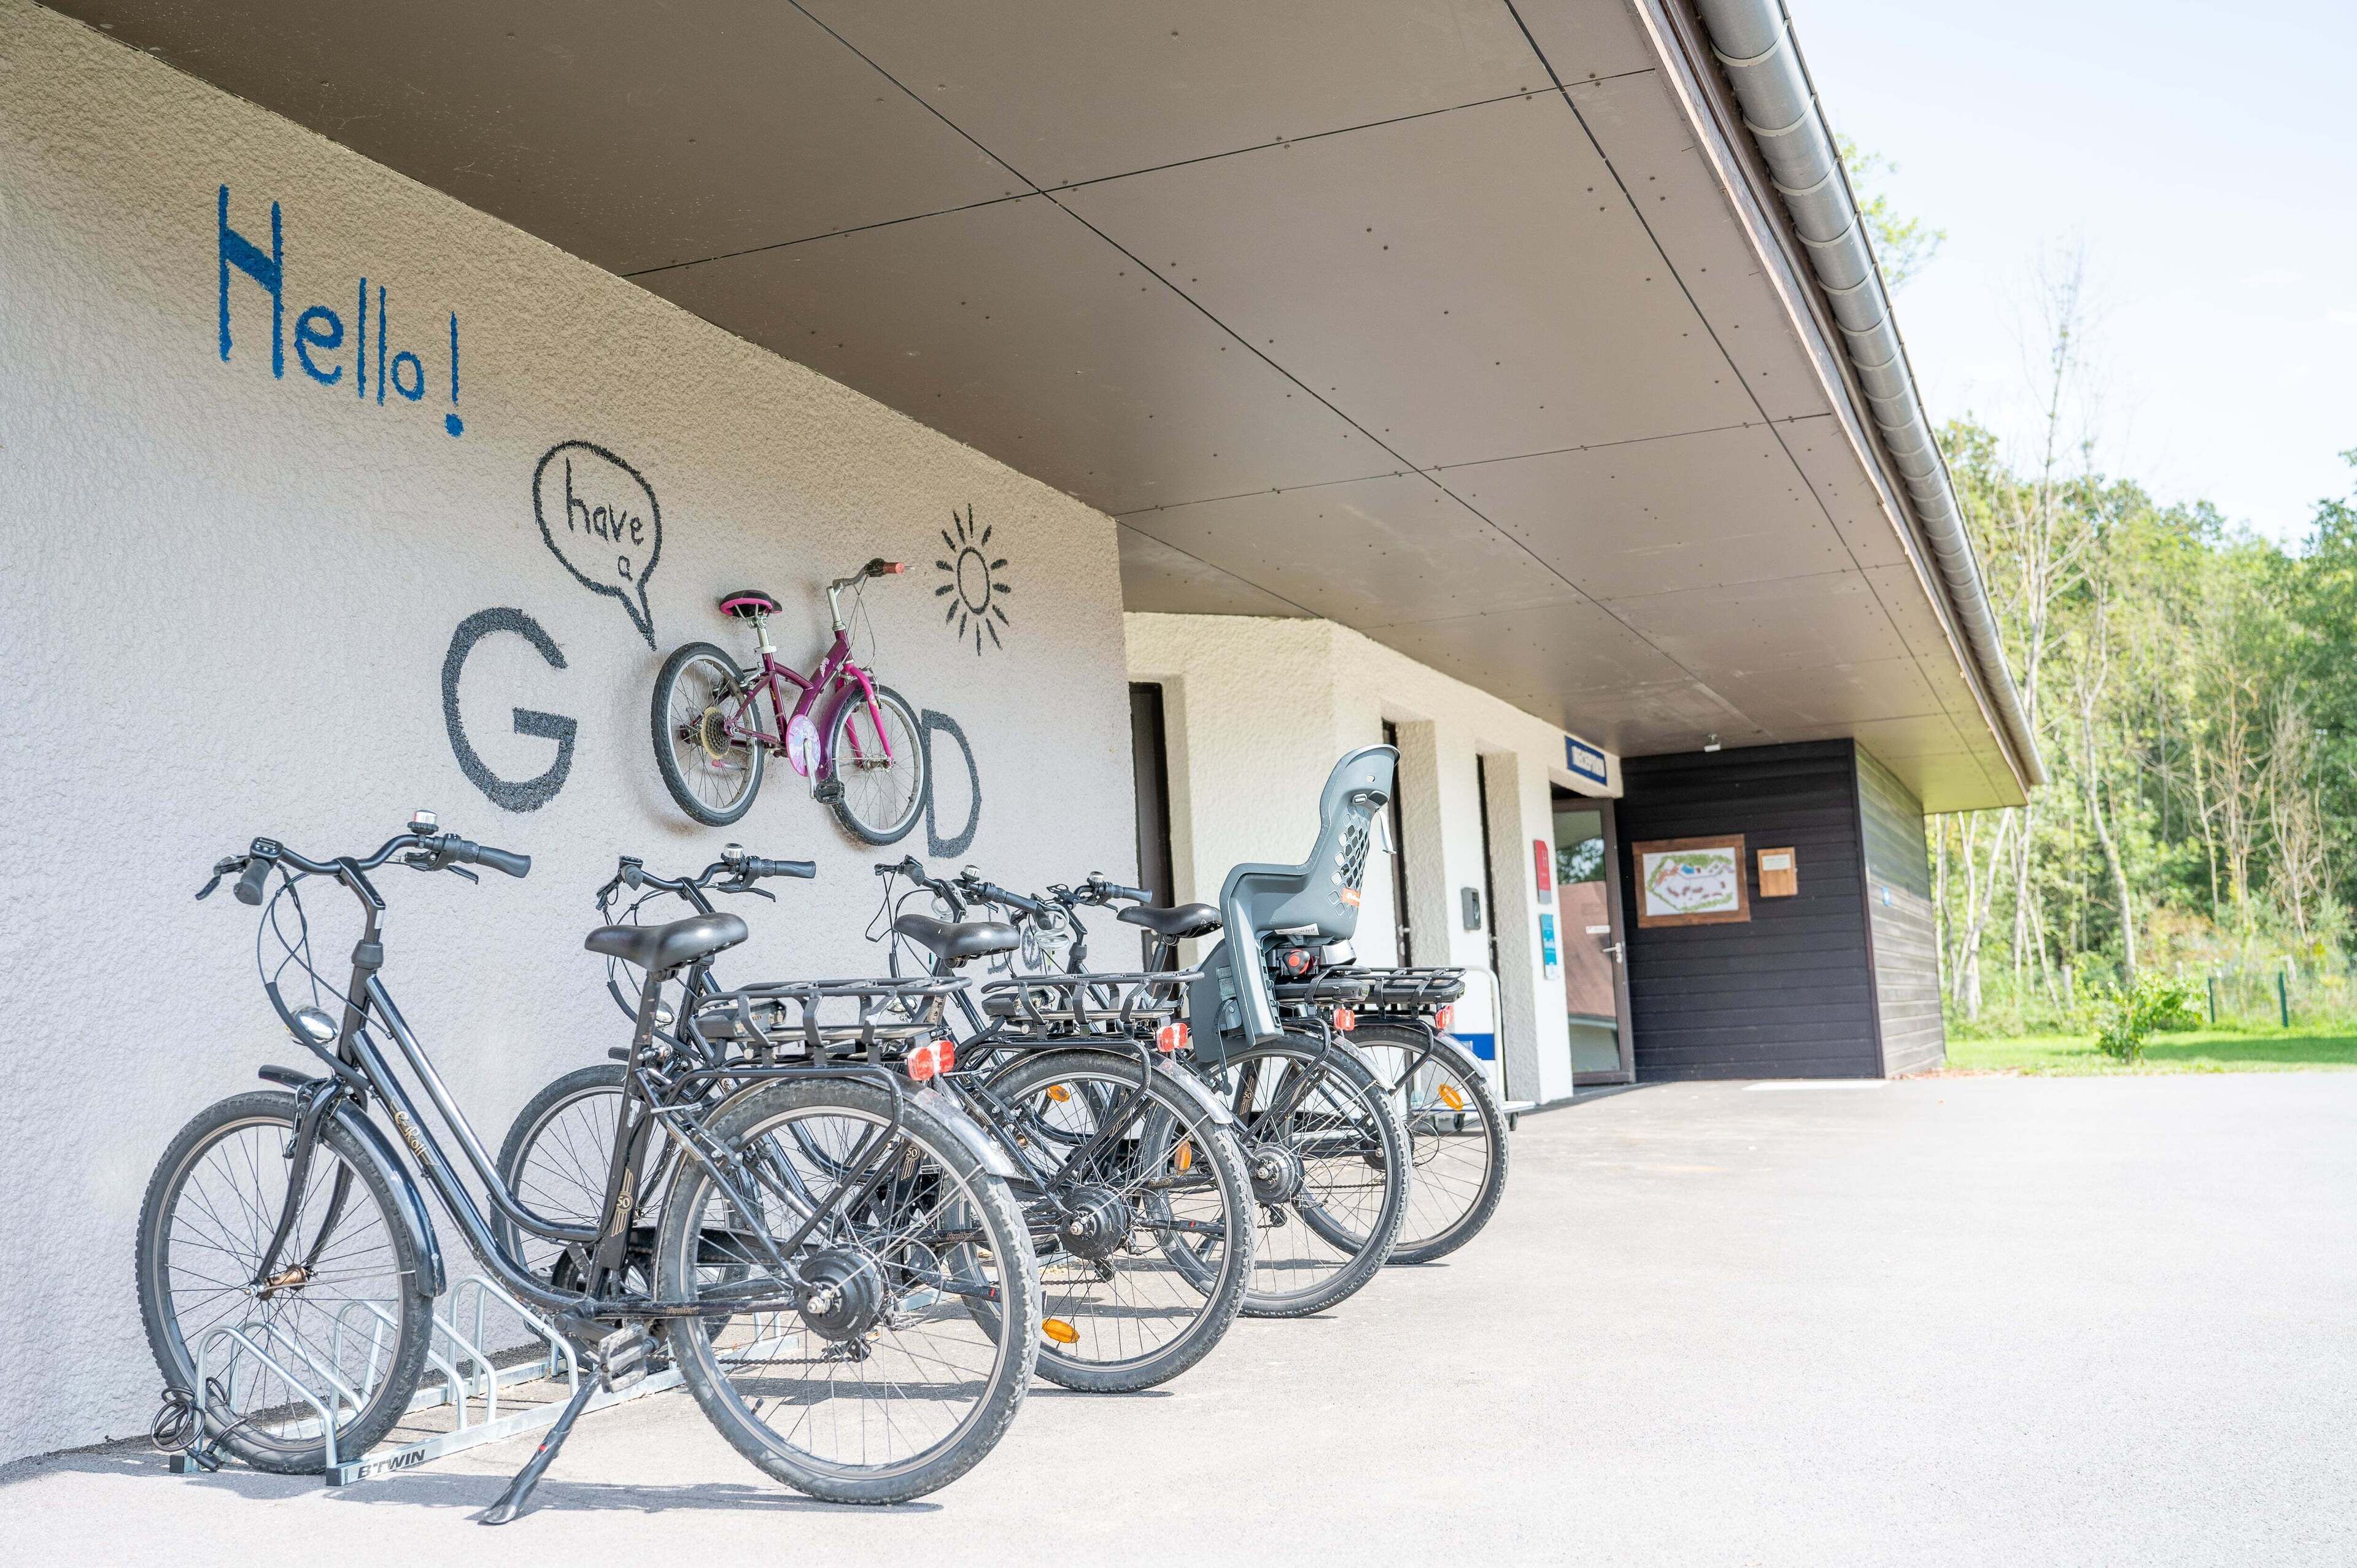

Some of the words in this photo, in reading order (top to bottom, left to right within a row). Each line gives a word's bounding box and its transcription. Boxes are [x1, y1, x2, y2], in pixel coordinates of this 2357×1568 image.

[219, 183, 465, 438] Hello!
[565, 457, 644, 546] have
[617, 555, 633, 581] a
[395, 1110, 427, 1156] e-Roll
[907, 1148, 918, 1157] 50
[617, 1197, 630, 1207] 50
